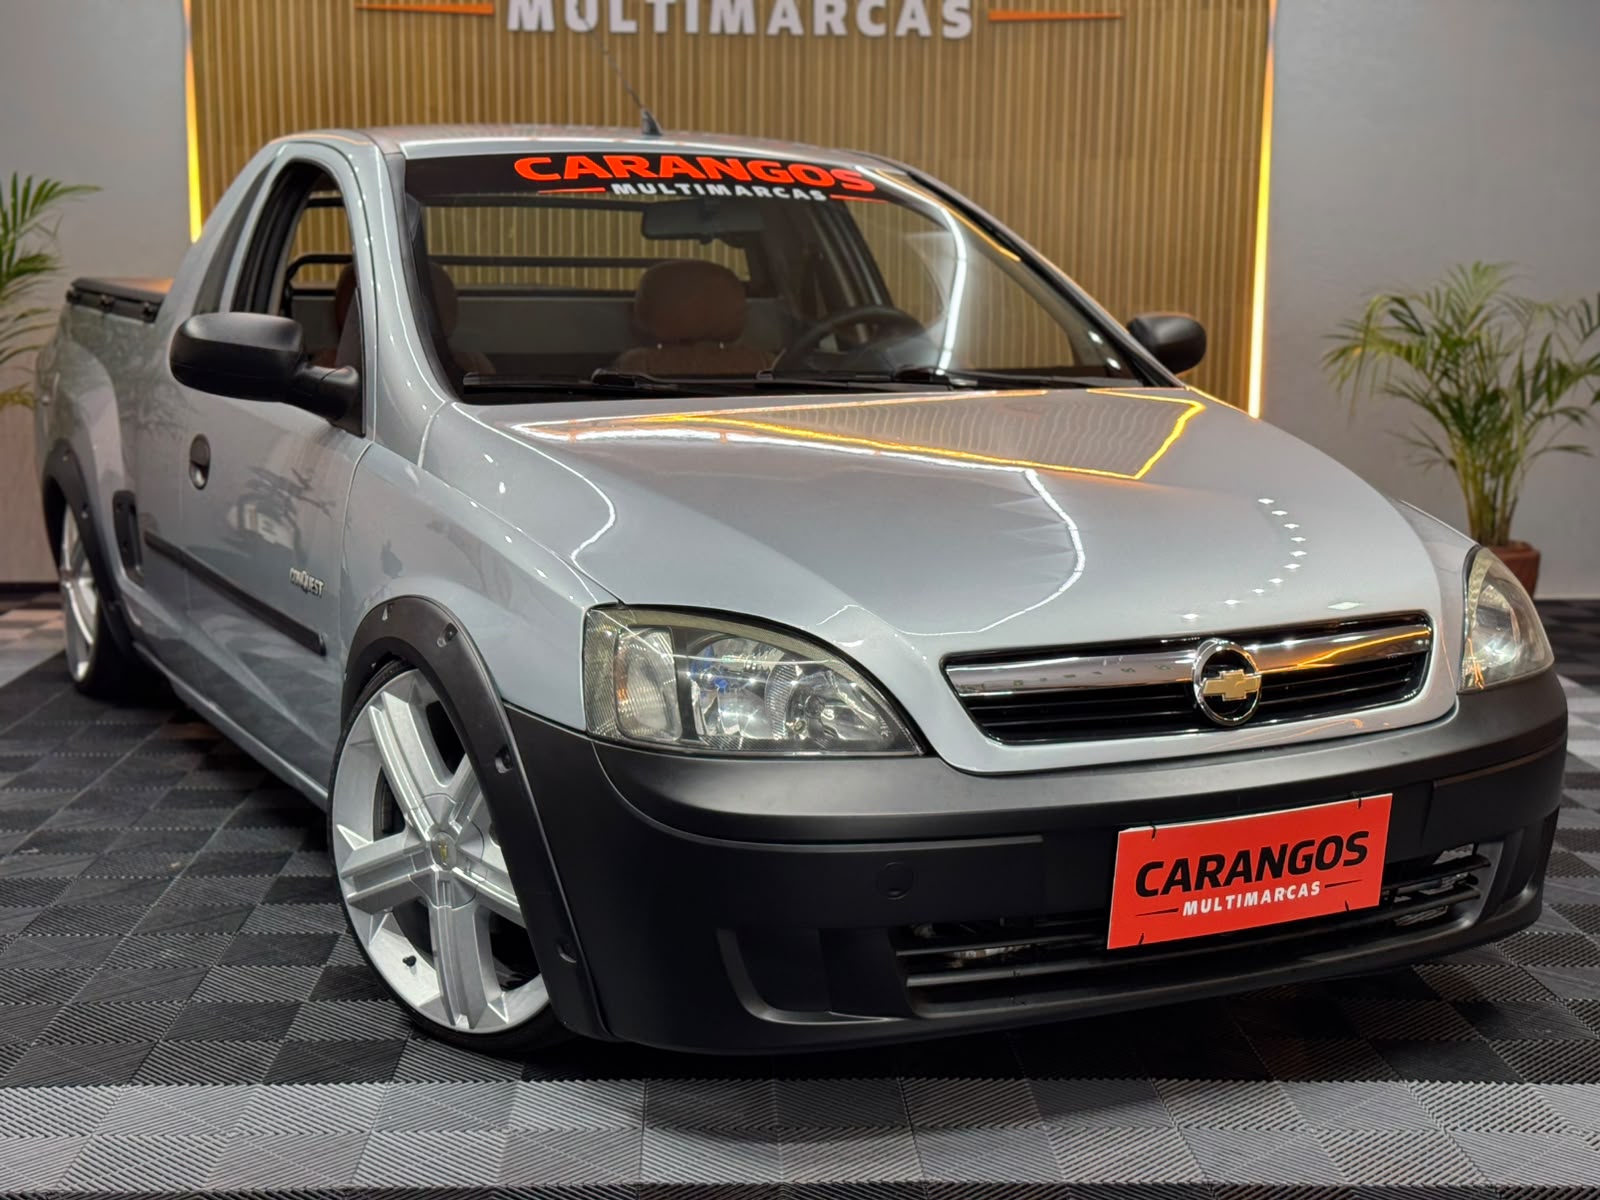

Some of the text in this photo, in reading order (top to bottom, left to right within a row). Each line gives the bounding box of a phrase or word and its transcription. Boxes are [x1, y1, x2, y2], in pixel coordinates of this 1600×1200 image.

[506, 0, 974, 39] MULTIMARCAS
[513, 155, 876, 193] CARANGOS
[611, 183, 828, 201] MULTIMARCAS
[1135, 830, 1370, 898] CARANGOS
[1182, 880, 1322, 917] MULTIMARCAS
